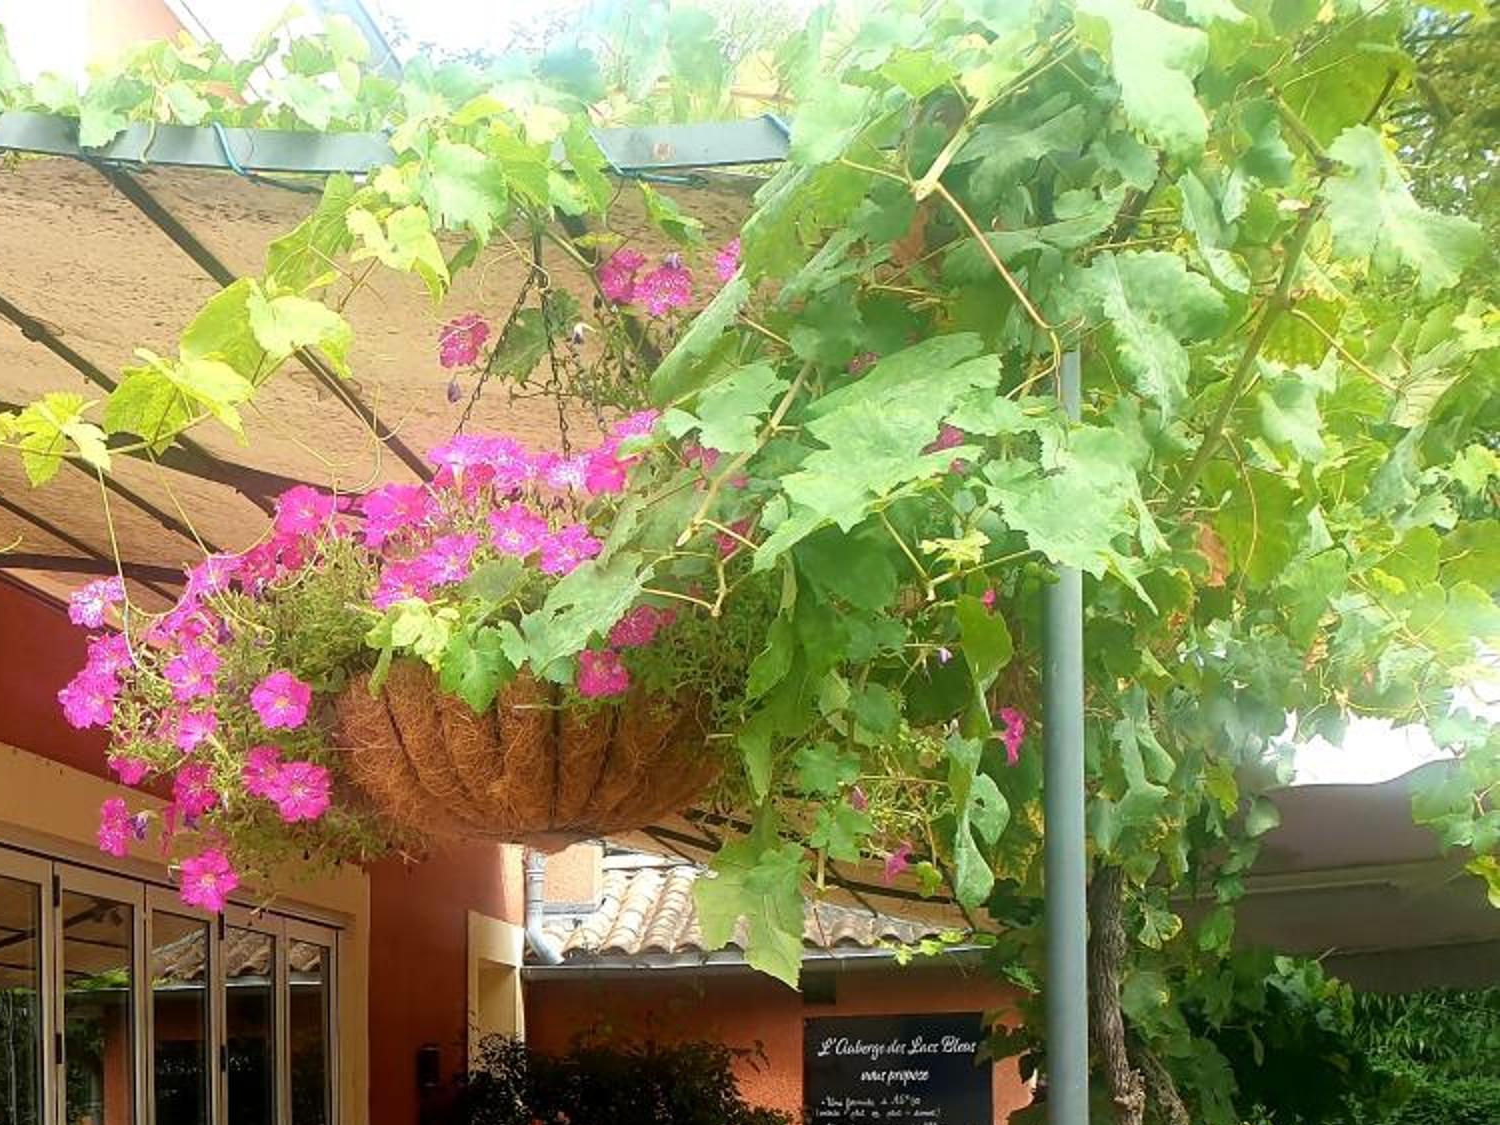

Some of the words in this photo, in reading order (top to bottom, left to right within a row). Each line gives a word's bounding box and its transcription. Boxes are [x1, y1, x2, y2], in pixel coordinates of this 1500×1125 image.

[817, 1037, 884, 1060] L'Auberge
[886, 1038, 905, 1054] des
[908, 1035, 937, 1054] Lacs
[940, 1035, 977, 1053] Bleus
[887, 1069, 930, 1086] propose
